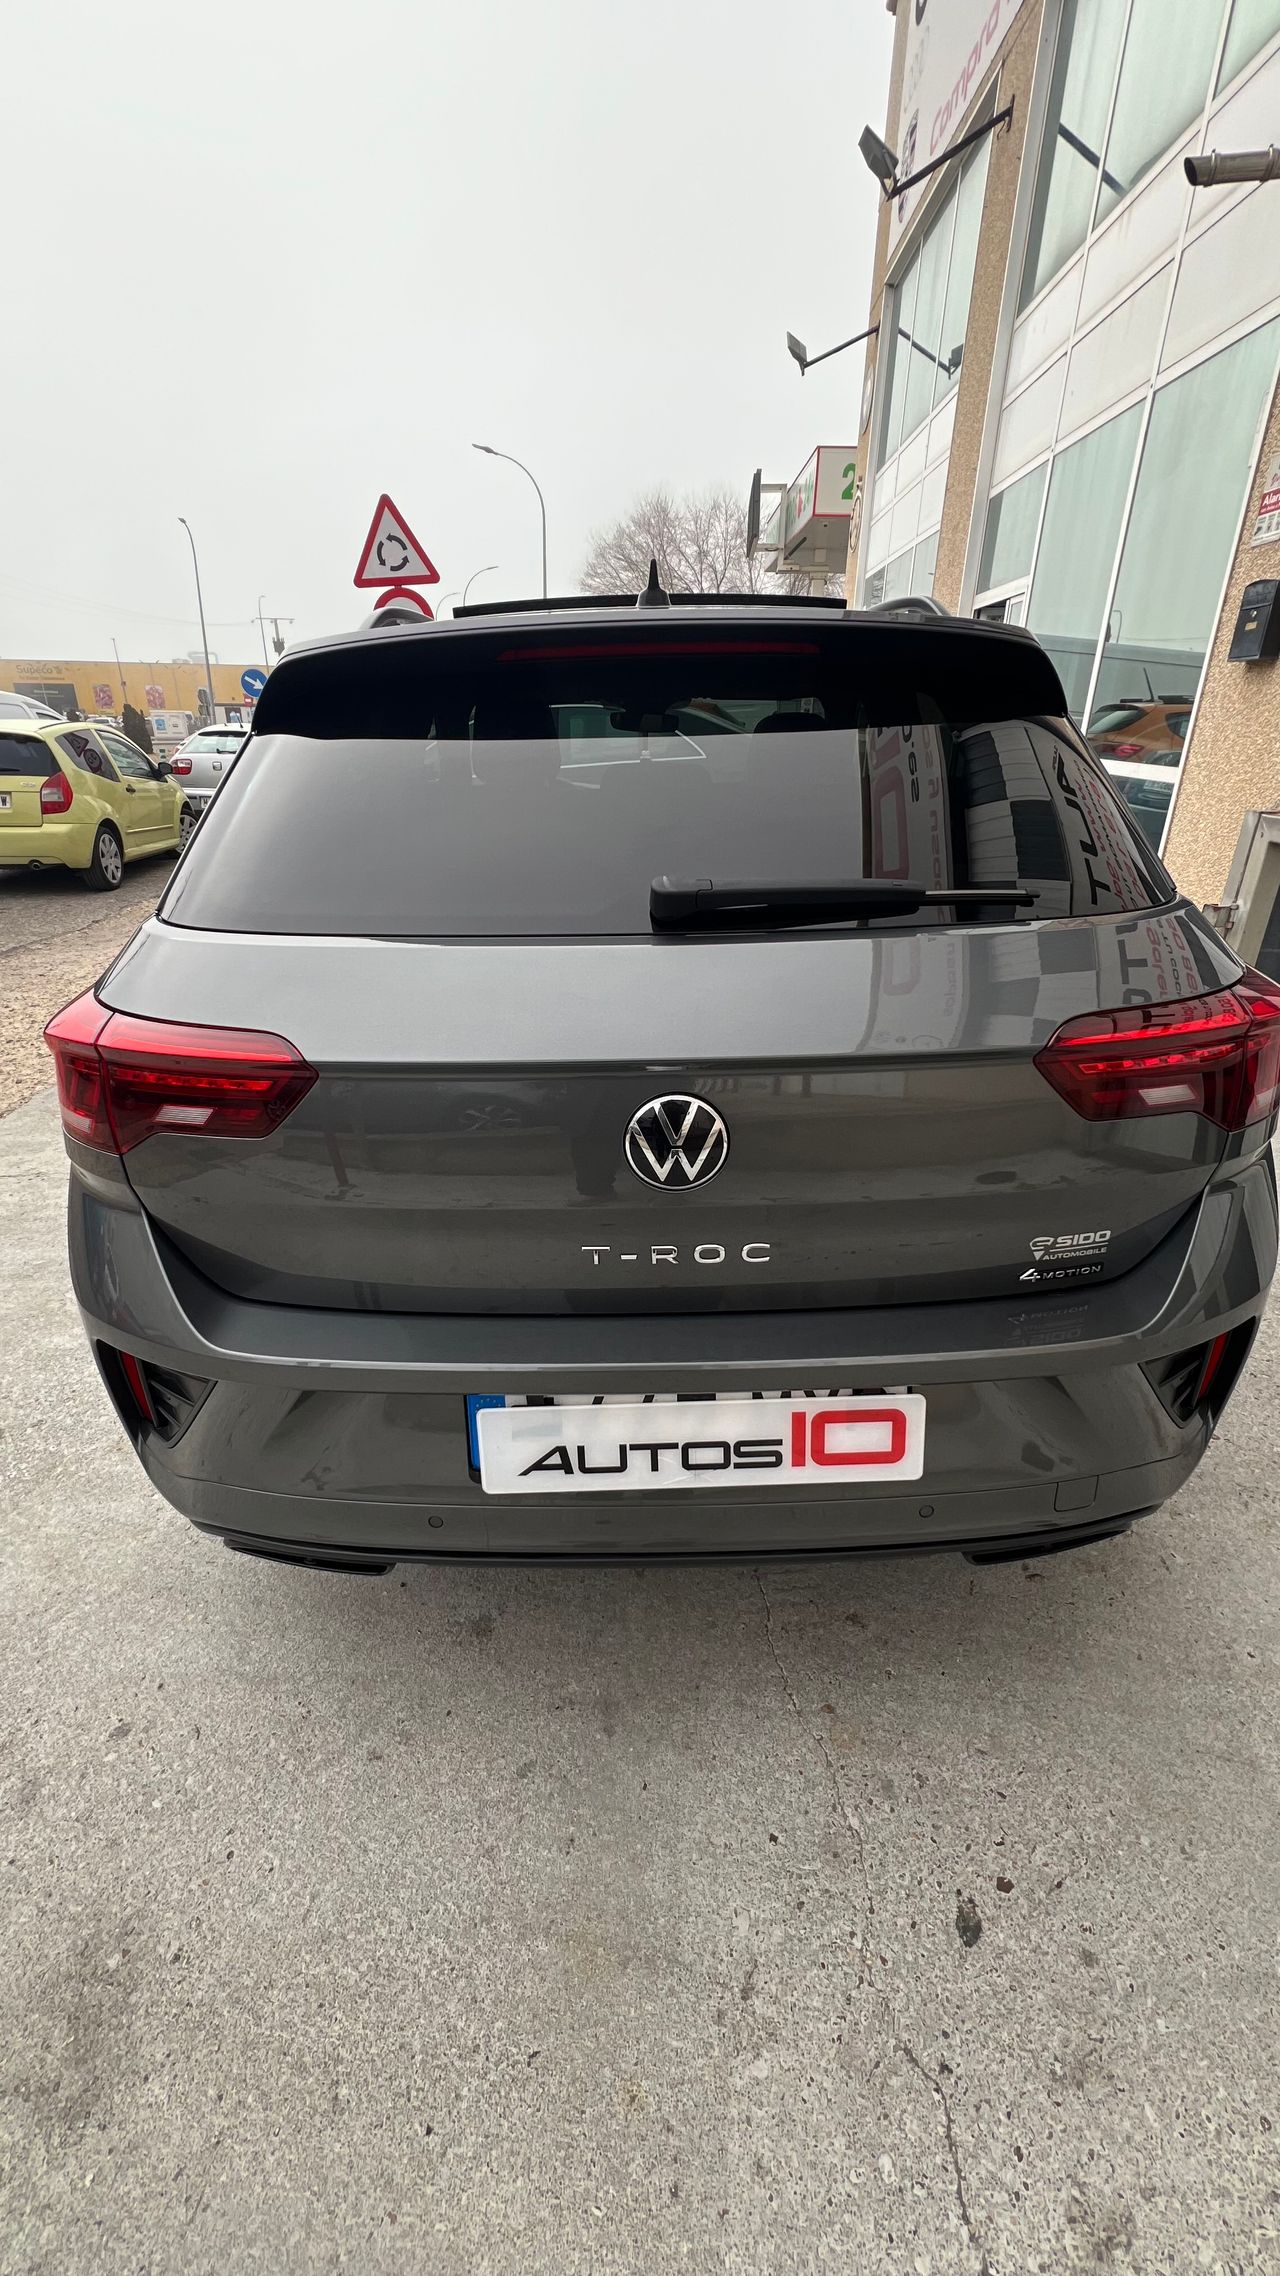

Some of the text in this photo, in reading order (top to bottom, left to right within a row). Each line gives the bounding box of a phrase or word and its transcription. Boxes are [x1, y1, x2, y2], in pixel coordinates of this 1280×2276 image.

[16, 663, 53, 675] Supeco
[581, 1242, 771, 1265] T-ROC
[1043, 1246, 1108, 1261] AUTOMOBILE
[1019, 1265, 1101, 1282] 4MOTION
